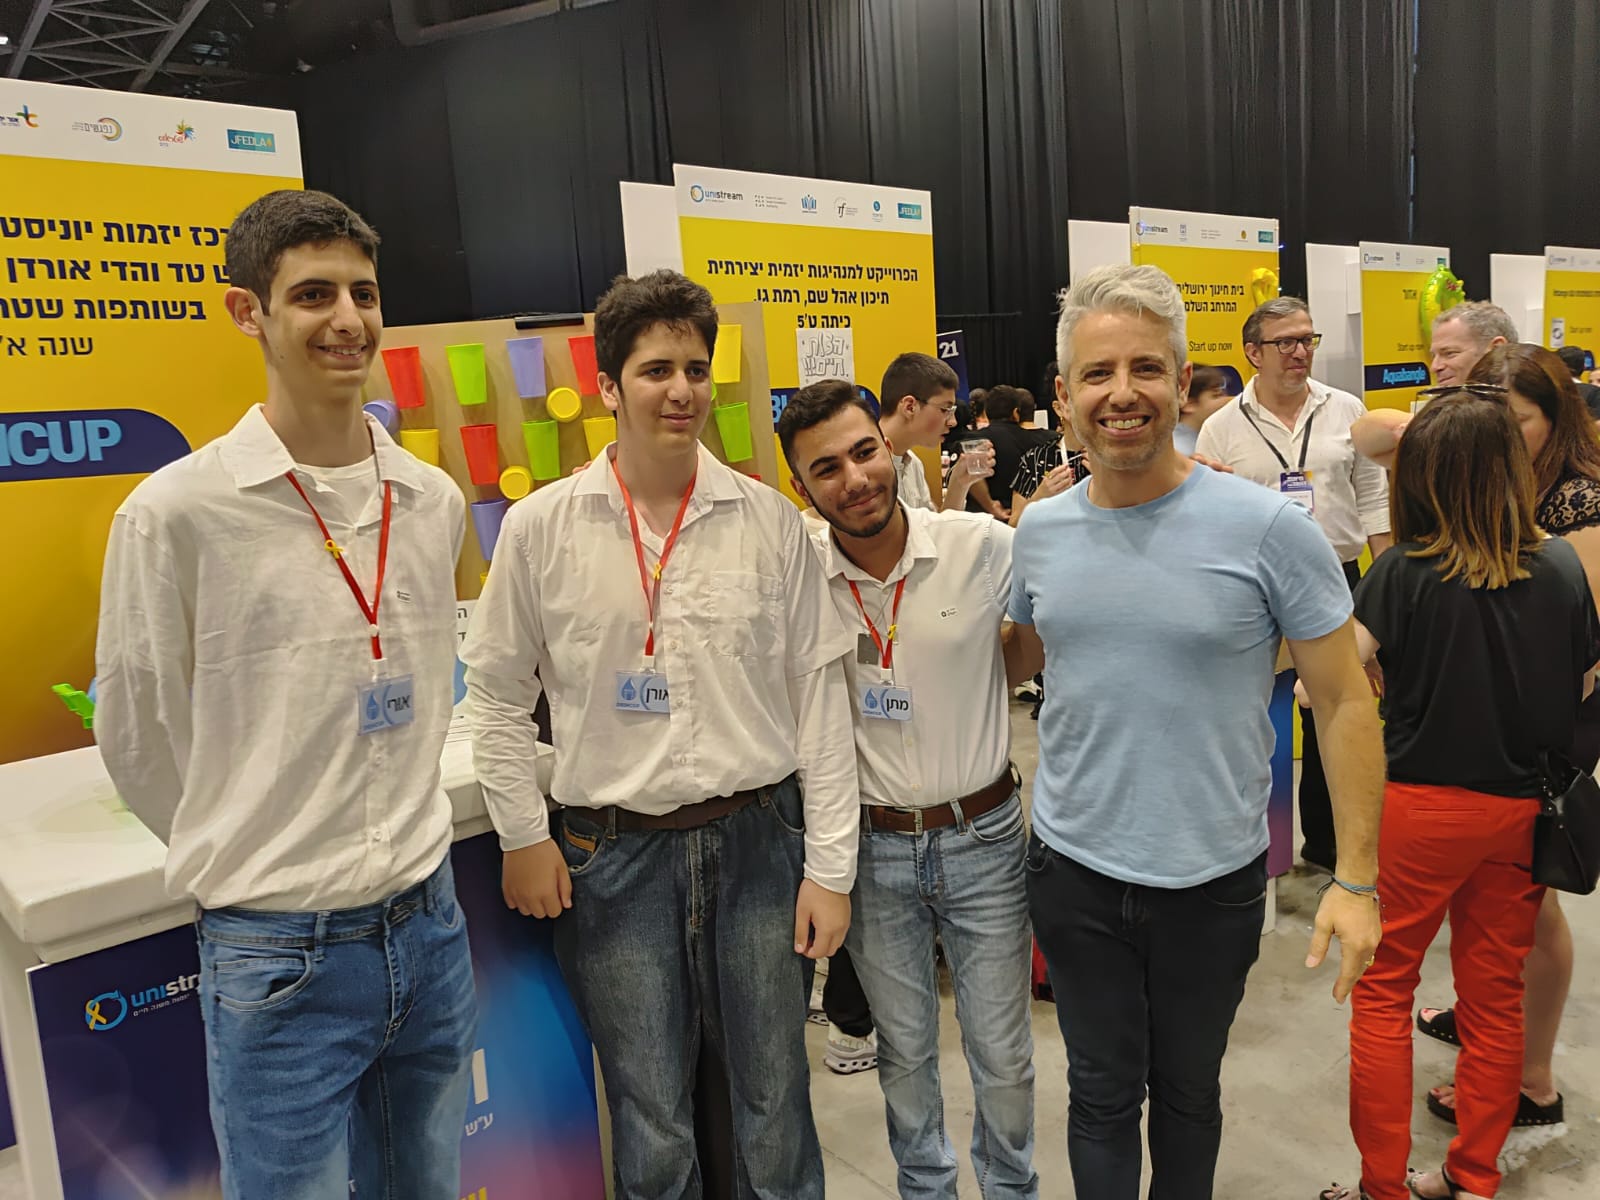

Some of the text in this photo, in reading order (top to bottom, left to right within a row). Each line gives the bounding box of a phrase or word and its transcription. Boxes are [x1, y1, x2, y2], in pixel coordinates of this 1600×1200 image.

[230, 134, 267, 147] JFEDLA
[704, 189, 744, 201] unistream
[103, 221, 181, 245] יזמות
[6, 257, 92, 283] אורדן
[101, 260, 160, 282] והדי
[168, 263, 205, 283] טד
[707, 259, 918, 284] הפרוייקט למנהיגות יזמית יצירתית
[772, 289, 801, 304] רמת
[804, 289, 829, 307] שם,
[831, 288, 857, 304] אהל
[860, 290, 889, 307] תיכון
[1209, 284, 1229, 297] חינוך
[1230, 285, 1245, 296] בית
[74, 299, 207, 320] בשותפות
[1210, 302, 1237, 313] המרחב
[821, 315, 851, 328] כיתה
[38, 337, 94, 356] שנה
[938, 340, 959, 358] 21
[1188, 341, 1233, 353] Start up now
[886, 698, 909, 712] מתן
[131, 973, 201, 1007] unistr
